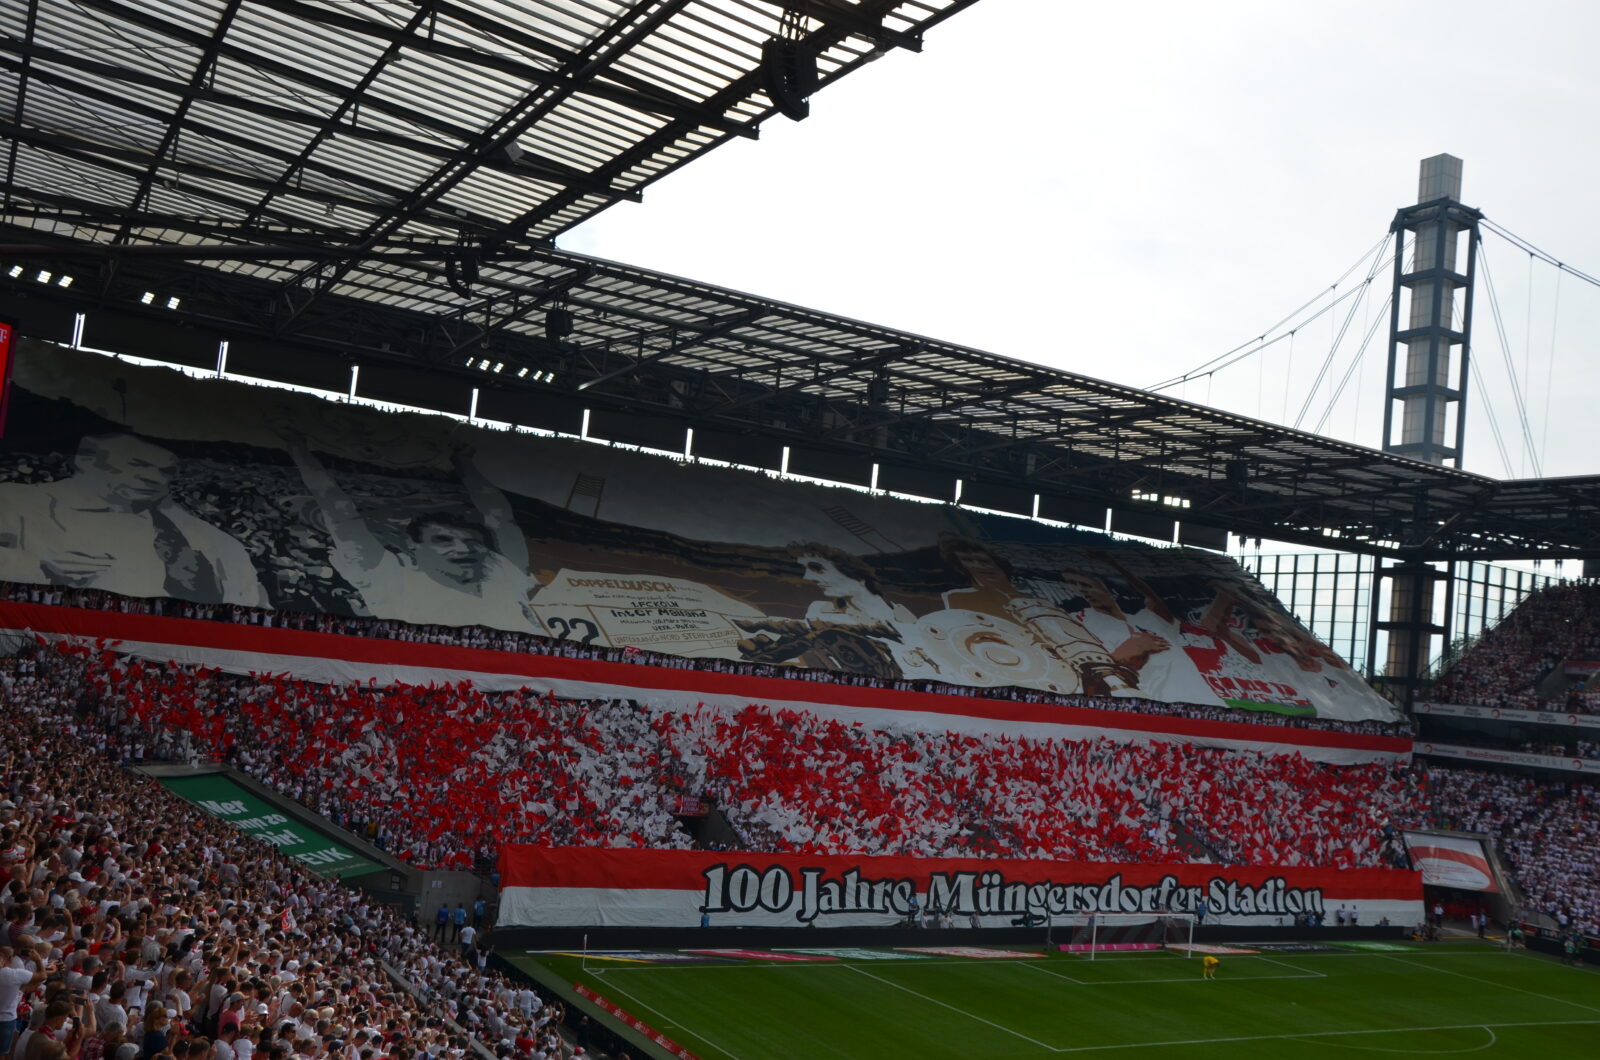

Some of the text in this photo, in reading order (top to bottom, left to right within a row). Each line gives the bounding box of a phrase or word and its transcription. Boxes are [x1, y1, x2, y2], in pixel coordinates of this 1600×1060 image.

[196, 799, 249, 816] Mer
[295, 847, 355, 865] EVK
[699, 863, 1325, 928] 100 Jahre Müngersdorfer Stadion
